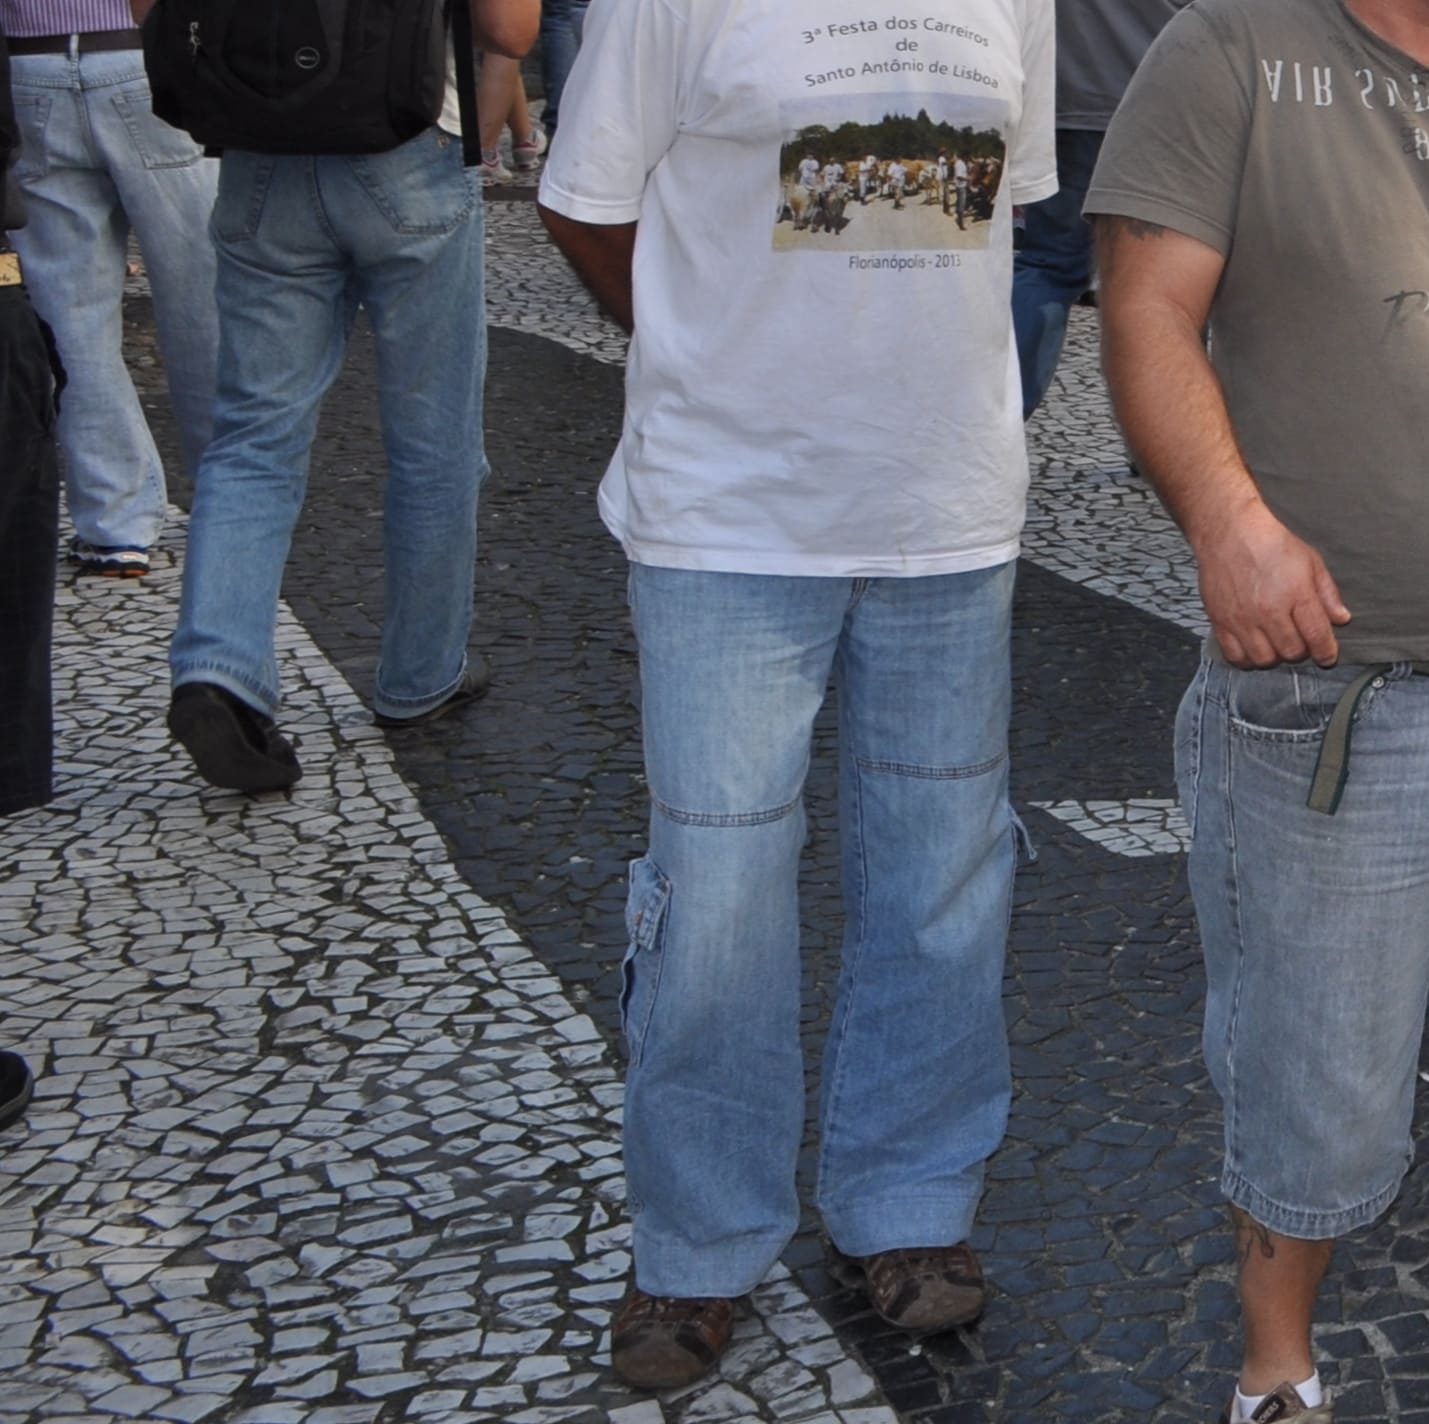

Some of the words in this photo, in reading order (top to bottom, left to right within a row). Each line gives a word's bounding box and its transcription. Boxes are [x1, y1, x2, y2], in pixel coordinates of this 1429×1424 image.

[827, 19, 878, 37] Festa
[885, 16, 918, 30] dos
[923, 17, 990, 47] Carreiros
[895, 37, 919, 52] de
[804, 66, 856, 88] Santo
[861, 58, 924, 76] Antônio
[928, 60, 948, 75] de
[952, 64, 999, 89] Lisboa
[848, 253, 926, 273] Florianópolis
